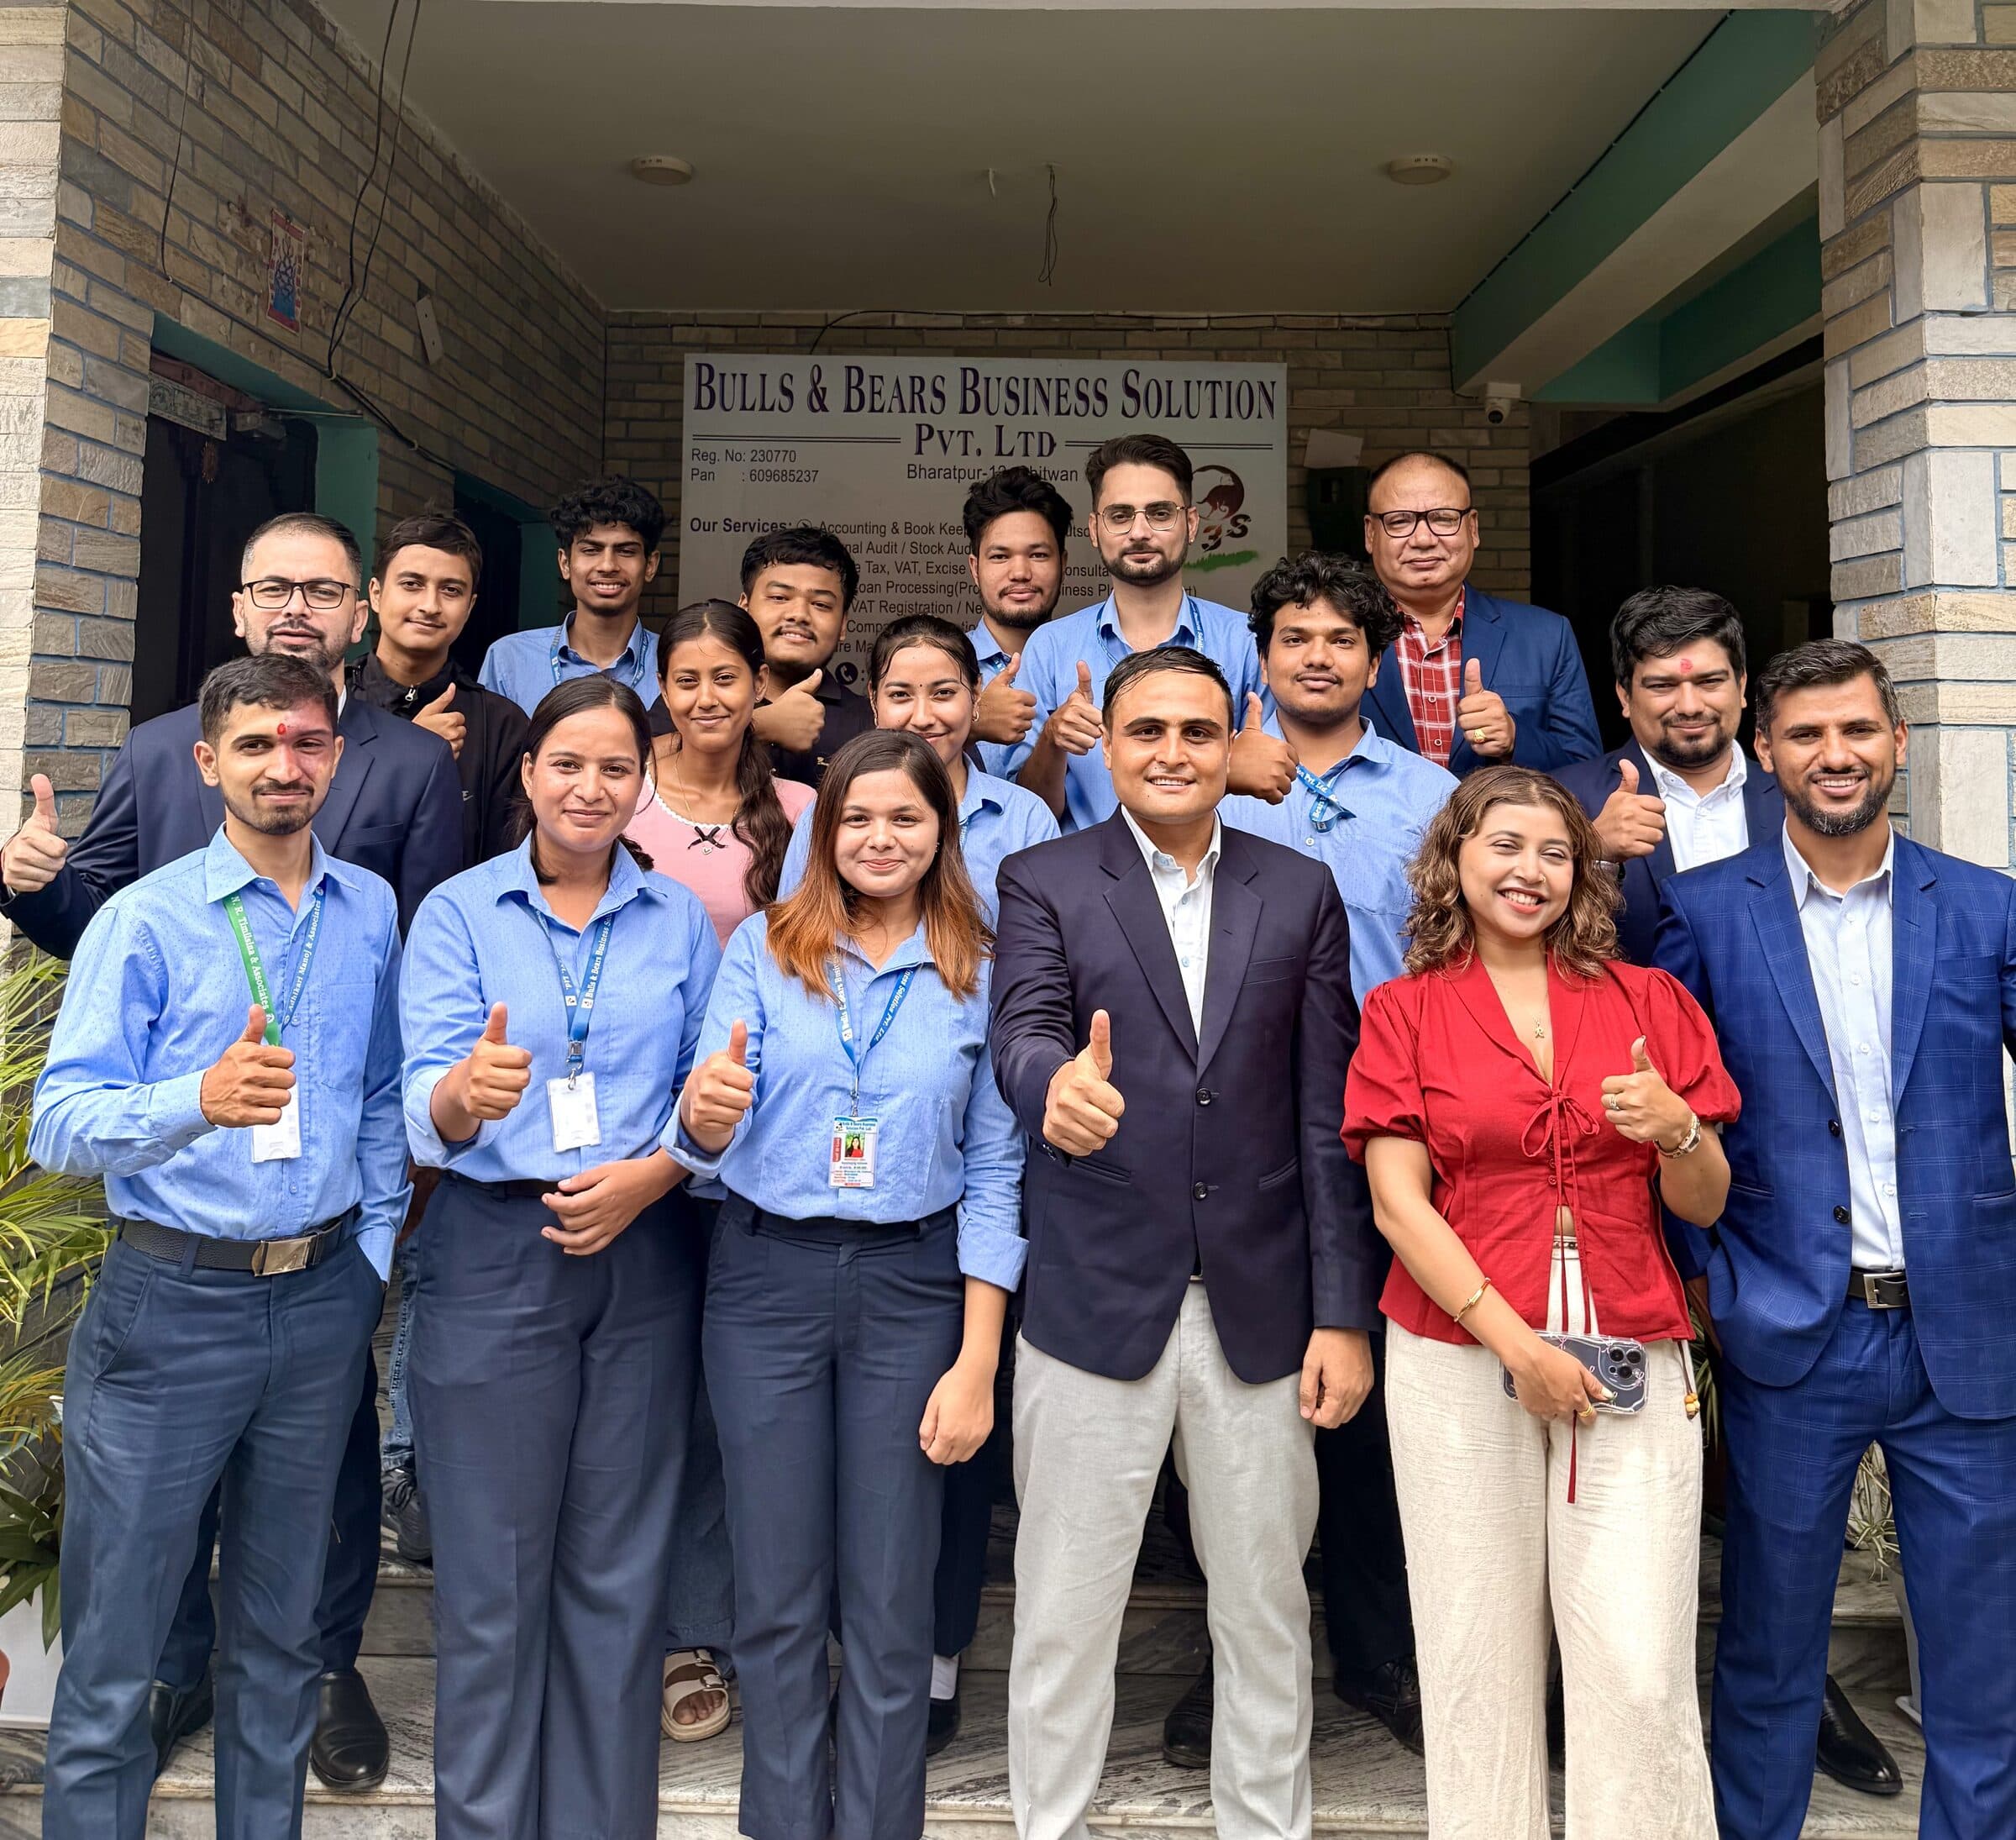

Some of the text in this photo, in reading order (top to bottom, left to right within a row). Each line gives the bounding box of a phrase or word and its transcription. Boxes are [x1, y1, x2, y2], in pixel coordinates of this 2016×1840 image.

[693, 362, 1277, 420] BULLS & BEARS BUSINESS SOLUTION
[691, 448, 797, 465] Reg. No: 230770
[690, 468, 716, 481] Pan
[749, 469, 819, 483] 609685237
[1029, 465, 1079, 481] hitwan
[690, 518, 718, 533] Our
[722, 518, 792, 533] Services:
[820, 521, 887, 537] Accounting
[890, 522, 900, 534] &
[904, 521, 935, 535] Book
[866, 541, 898, 555] Audit
[910, 542, 947, 555] Stock
[948, 542, 972, 555] Aud
[864, 560, 890, 576] Tax,
[894, 560, 921, 576] VAT,
[926, 561, 966, 576] Excise
[1064, 565, 1110, 577] onsulta
[856, 583, 882, 593] oan
[886, 581, 981, 597] Processing(Pro
[1062, 583, 1094, 597] iness
[851, 599, 874, 613] VAT
[879, 600, 953, 615] Registration
[965, 602, 983, 614] Ne
[249, 956, 260, 965] &
